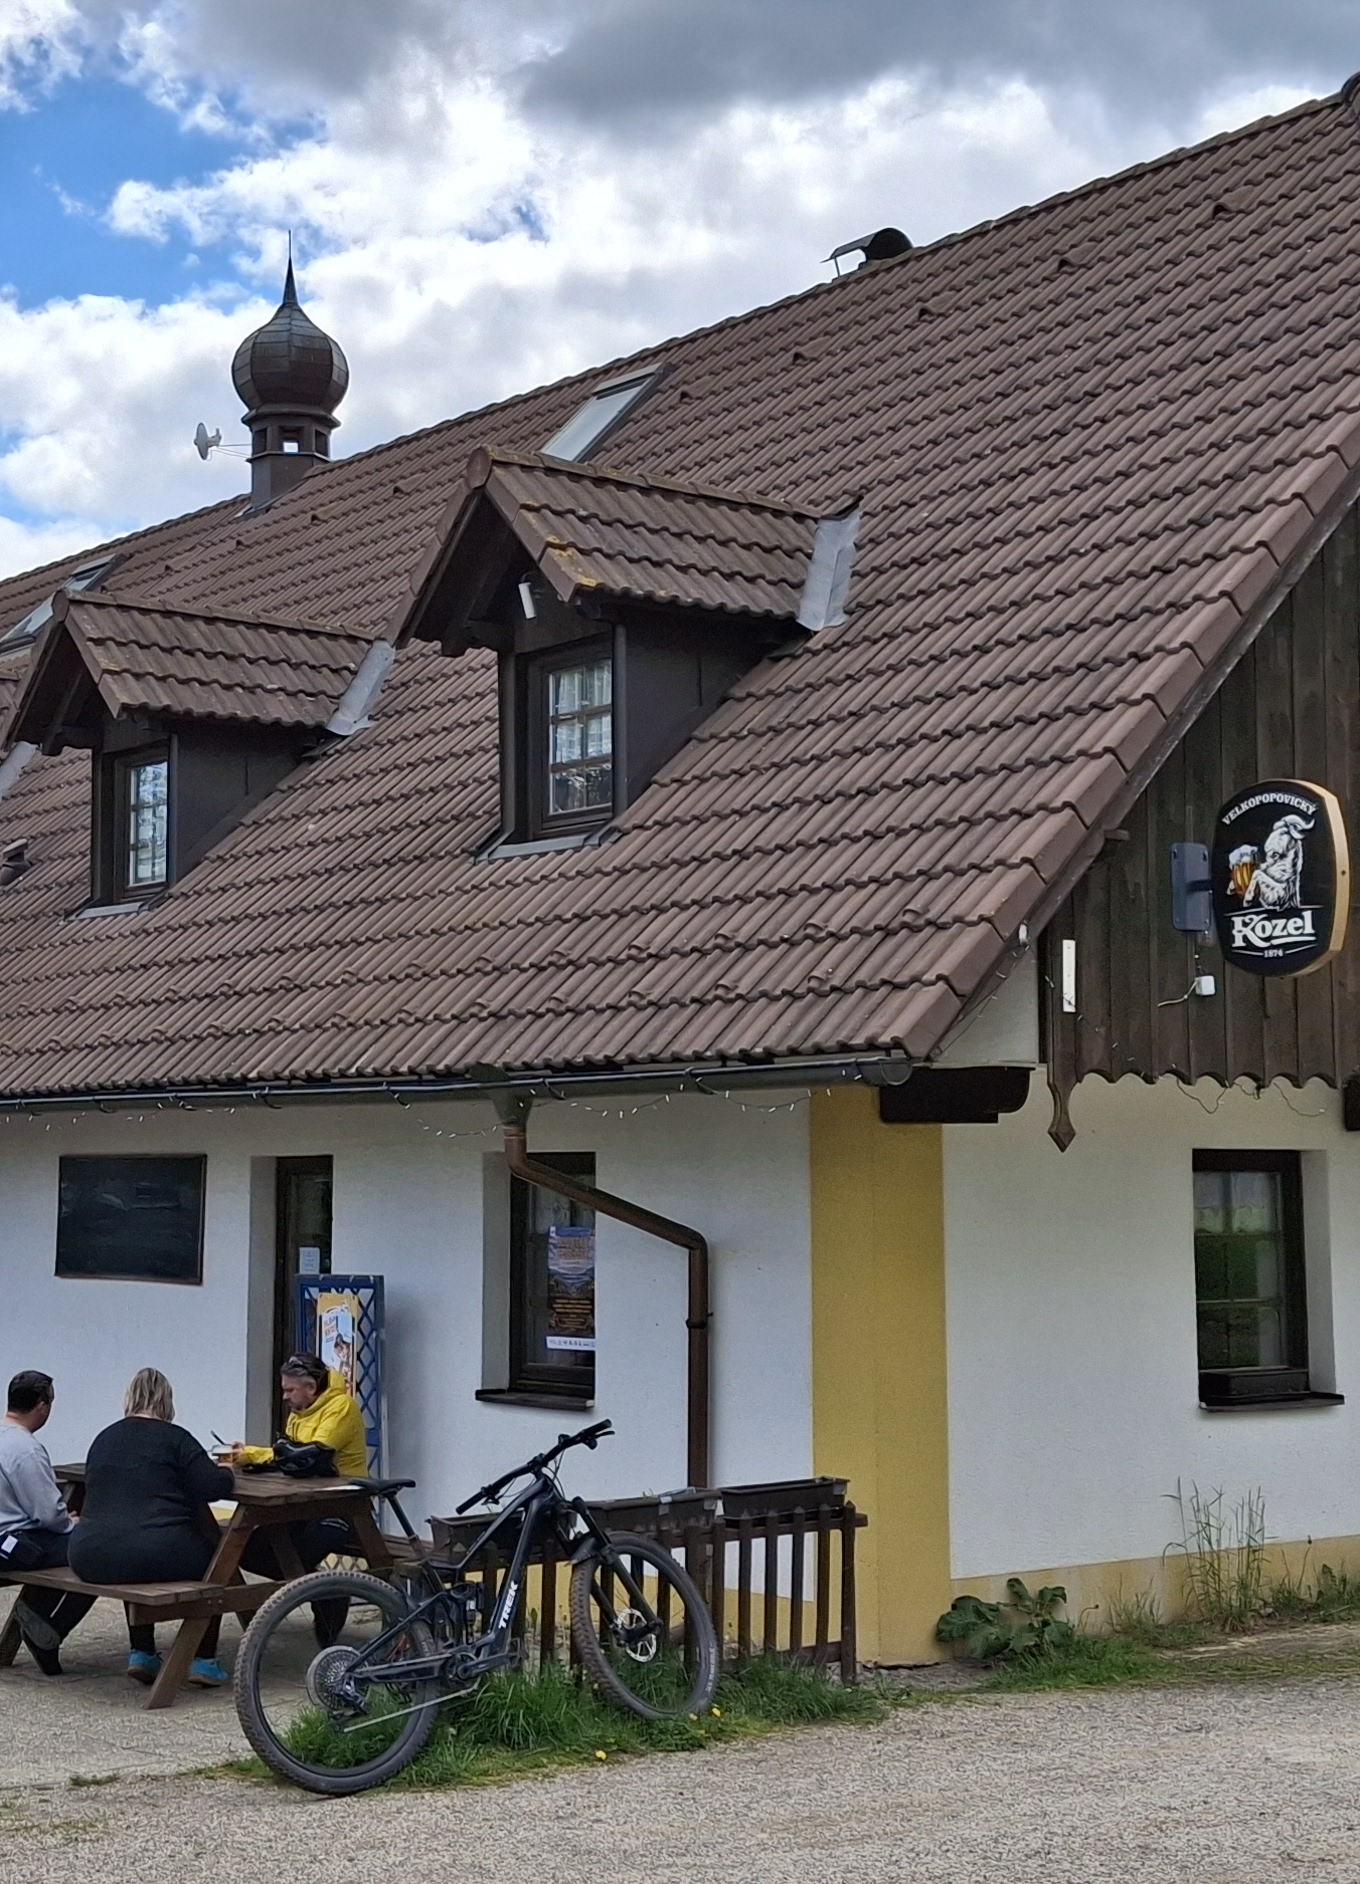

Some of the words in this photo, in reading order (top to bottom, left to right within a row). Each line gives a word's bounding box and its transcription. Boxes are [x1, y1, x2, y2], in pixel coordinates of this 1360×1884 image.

[1221, 792, 1318, 826] VELKOPOPOVICKÝ
[1231, 910, 1316, 948] Kozel
[1263, 949, 1284, 958] 1874
[498, 1580, 519, 1629] TREK
